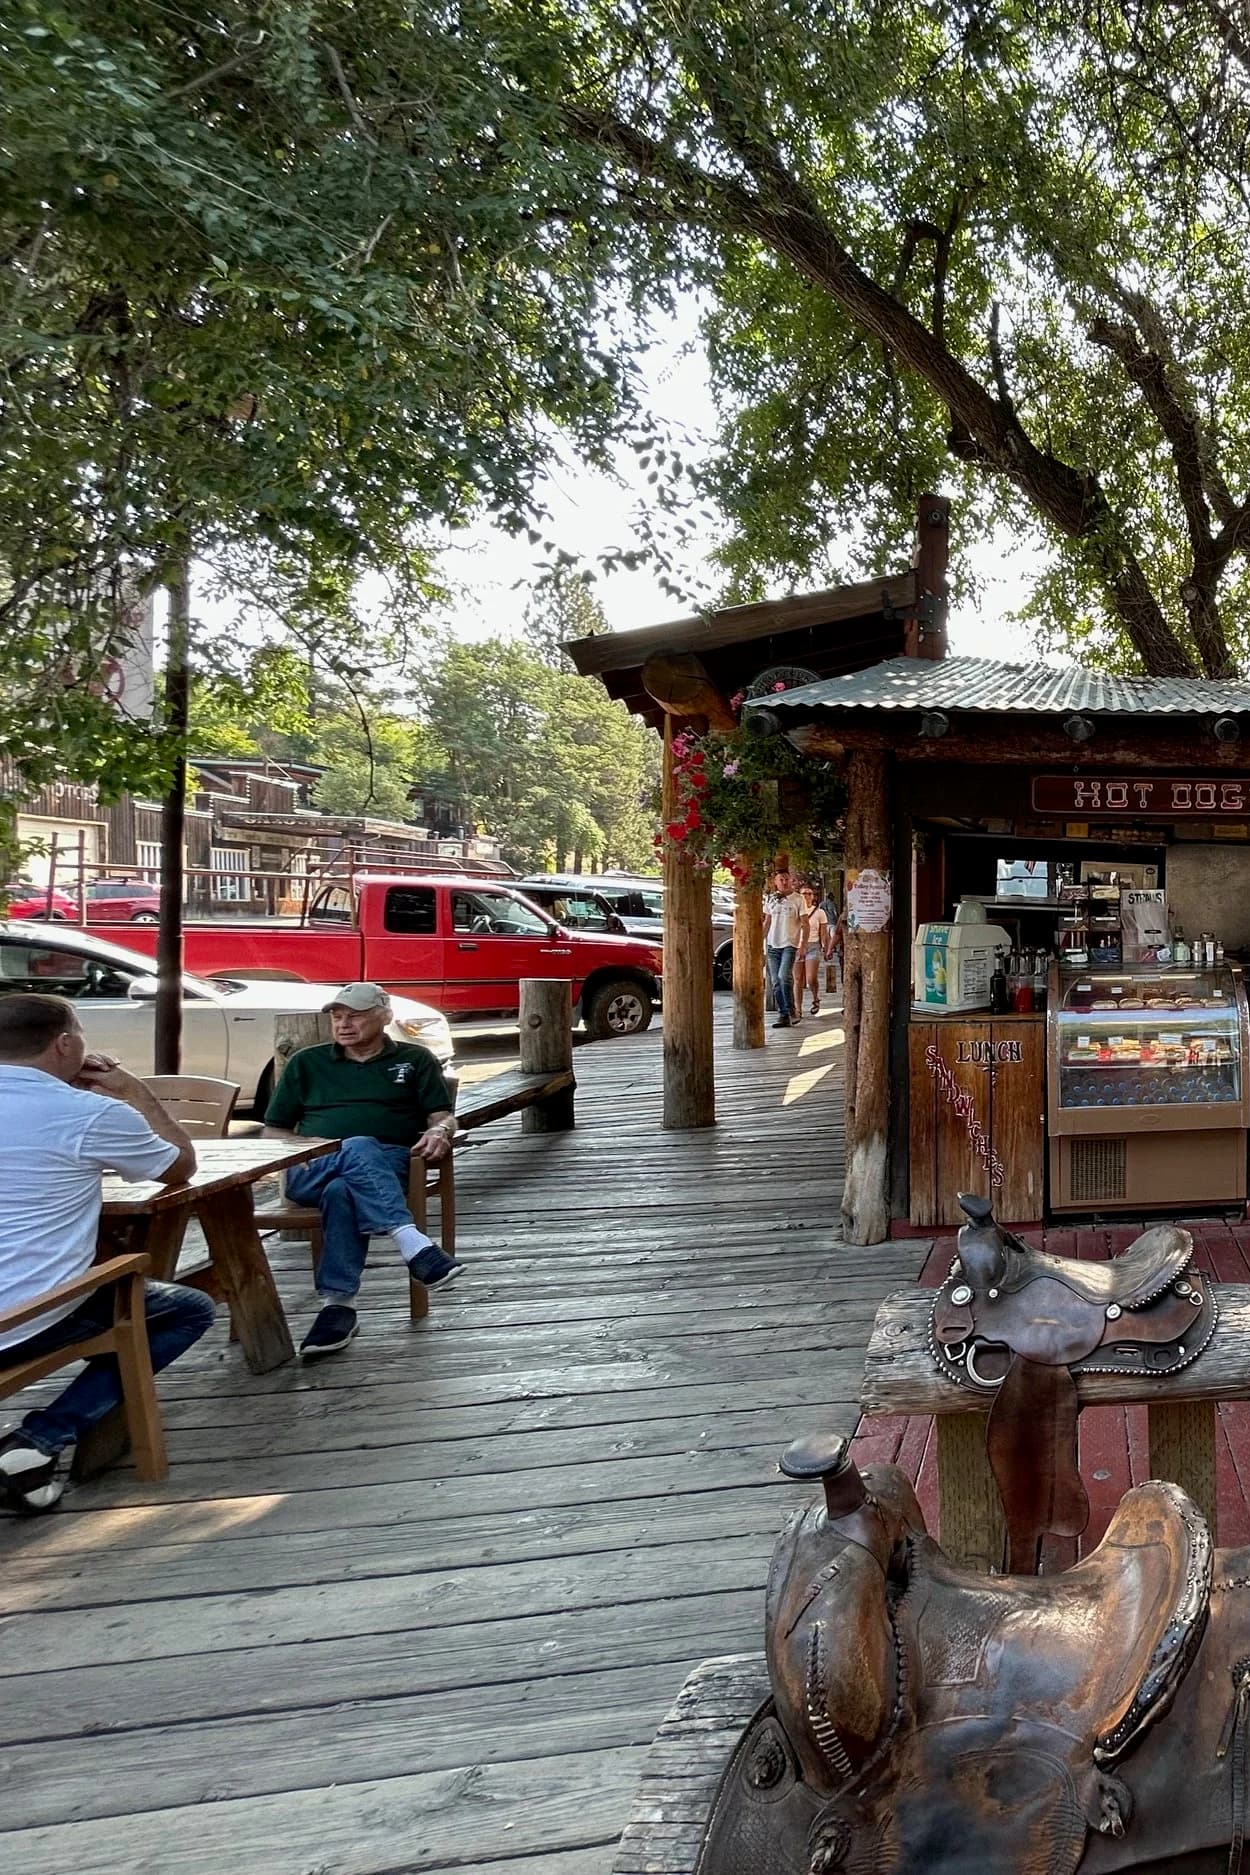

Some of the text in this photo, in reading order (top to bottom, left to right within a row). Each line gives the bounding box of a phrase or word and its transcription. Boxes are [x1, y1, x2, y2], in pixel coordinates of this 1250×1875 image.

[1073, 781, 1153, 808] HOT
[955, 1040, 1024, 1064] LUNCH
[924, 1045, 1005, 1187] SANDWICHES
